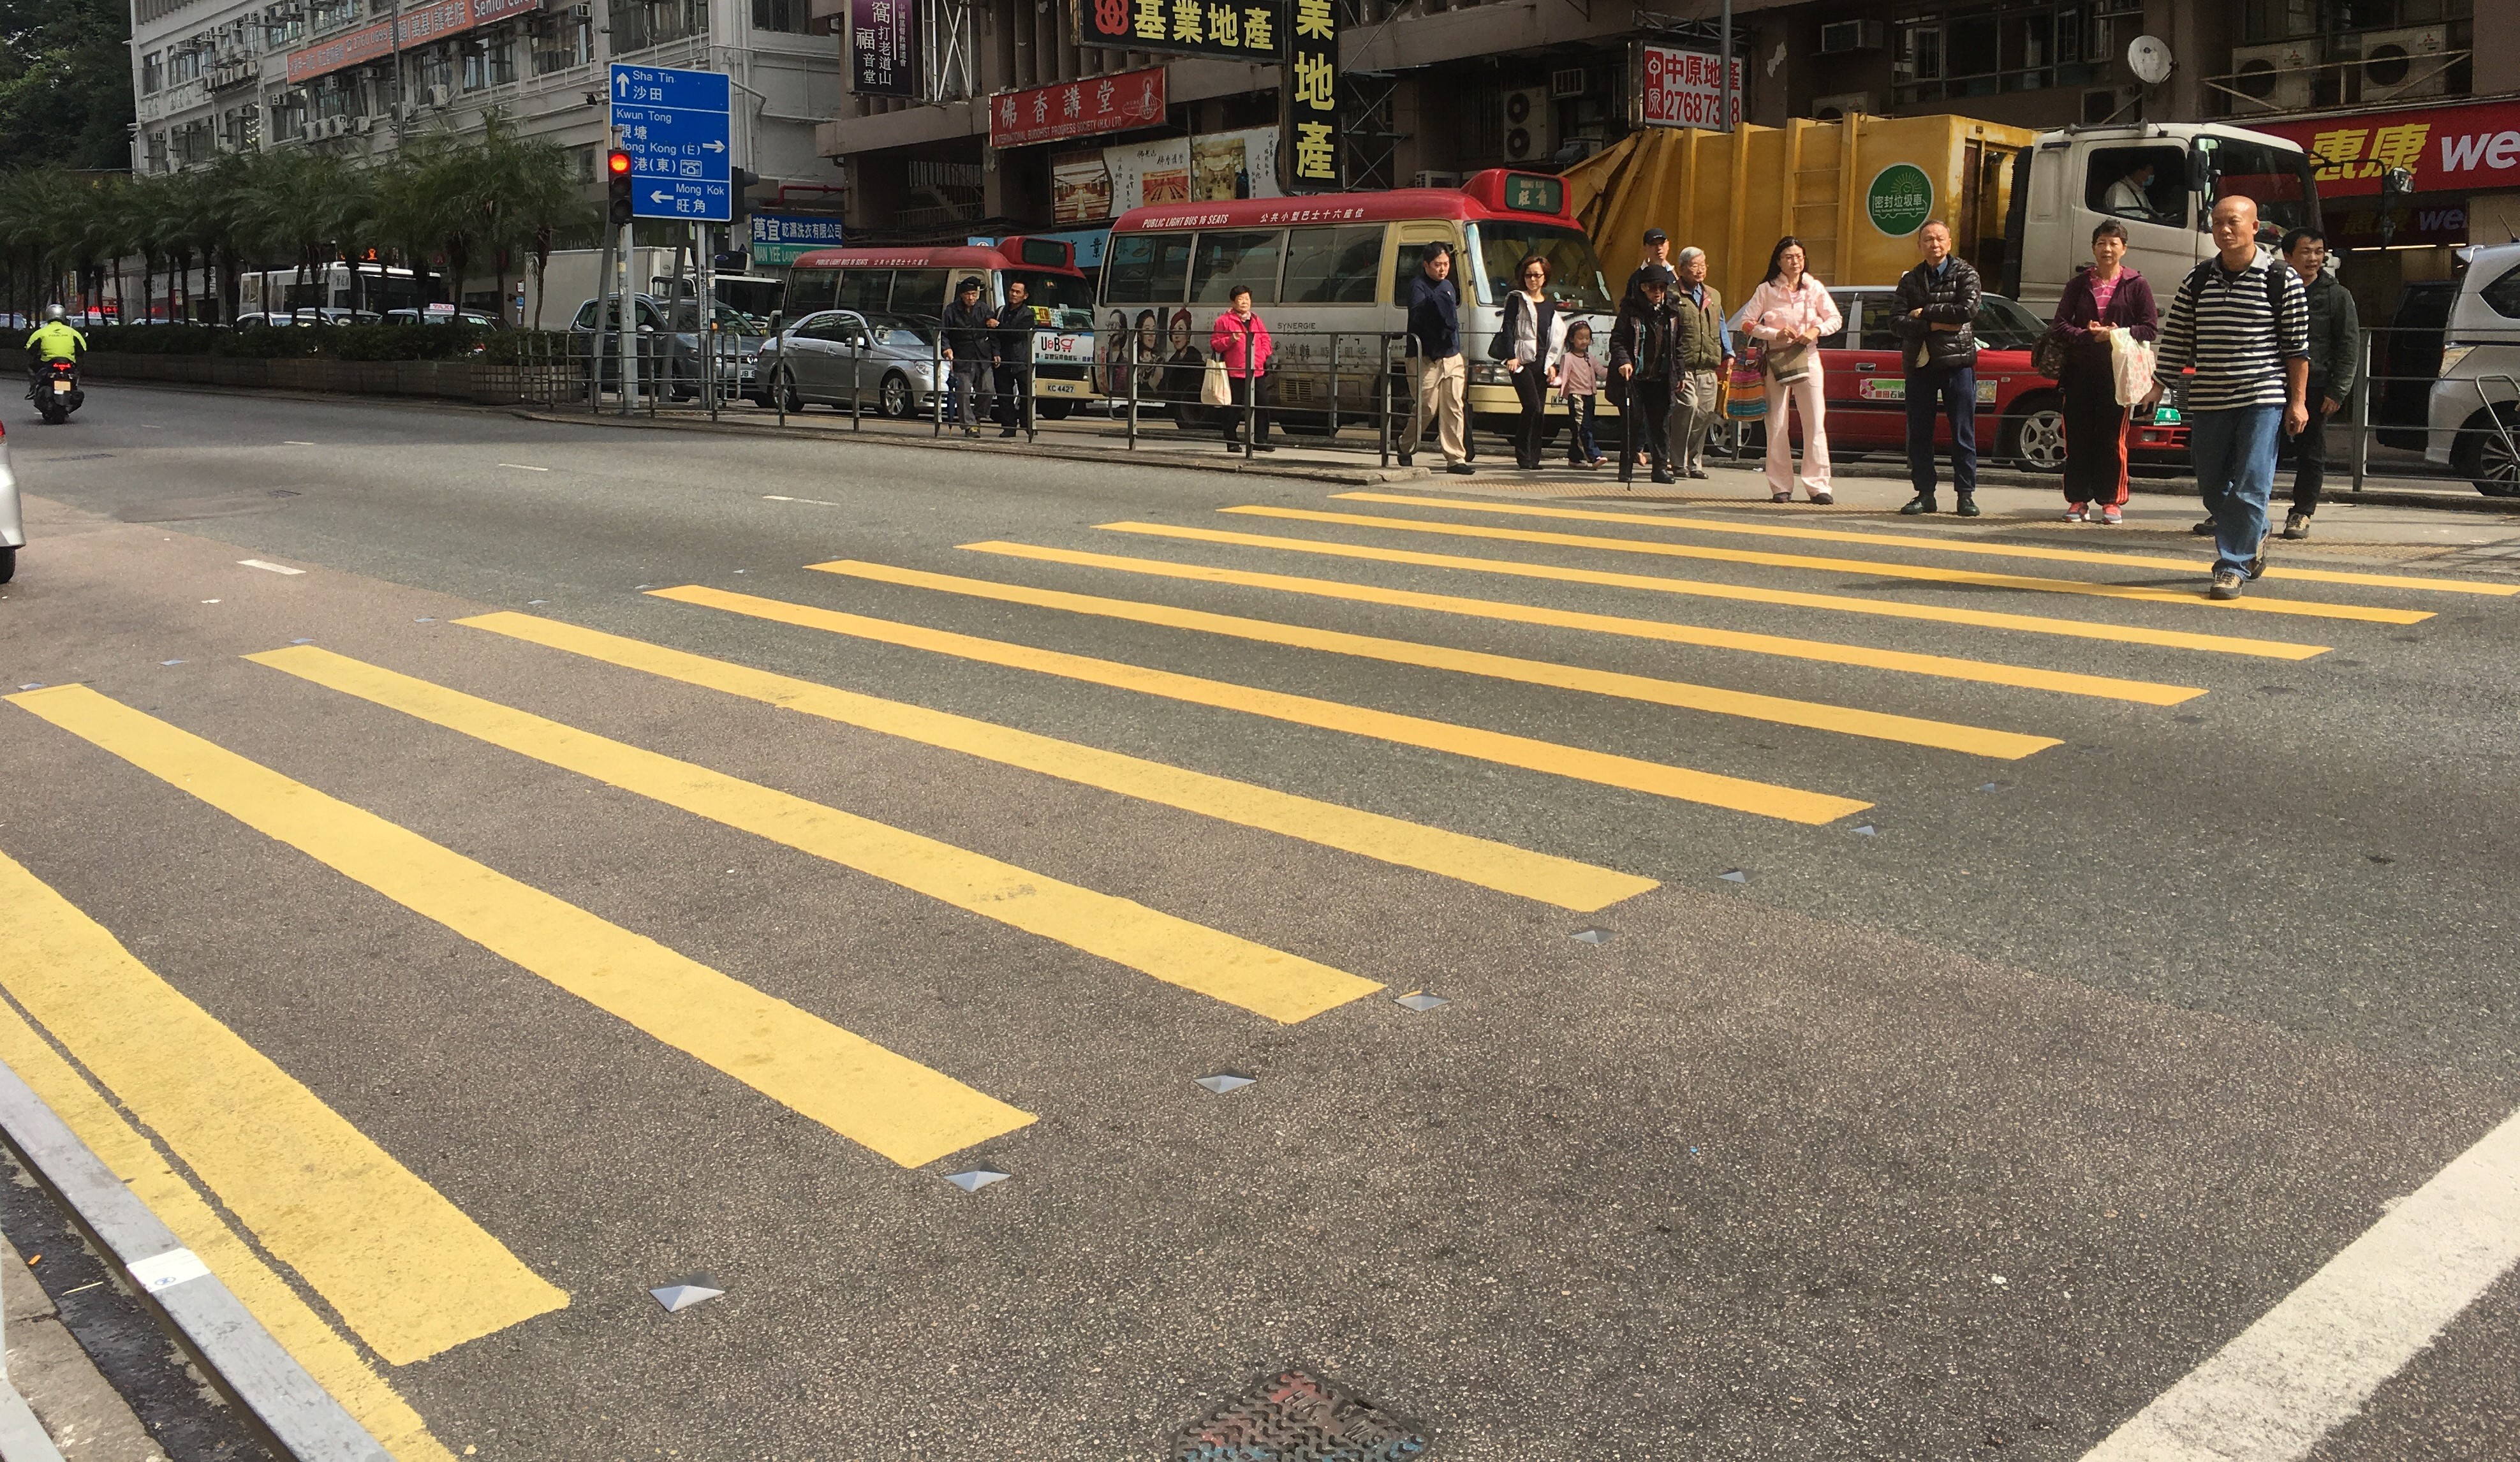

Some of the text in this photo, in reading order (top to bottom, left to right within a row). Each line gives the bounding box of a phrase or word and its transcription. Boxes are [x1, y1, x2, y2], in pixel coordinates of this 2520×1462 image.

[1134, 0, 1274, 50] 基業地產
[872, 1, 892, 85] 窩打老道山
[856, 27, 876, 84] 福音堂
[633, 70, 674, 84] Sha Tin
[1665, 54, 1741, 91] 中原地產
[633, 85, 662, 101] 沙田
[1295, 0, 1336, 179] 業地產
[999, 80, 1115, 129] 佛香講堂
[617, 108, 672, 124] Kwun Tong
[994, 131, 1027, 144] INTERNATIONAL
[1028, 127, 1050, 140] BUDDHIST
[1051, 122, 1075, 136] PROGRESS
[1077, 119, 1096, 133] SOCIETY
[650, 142, 676, 156] Kong
[682, 144, 700, 156] (E)
[2310, 123, 2431, 182] 惠康
[2441, 130, 2520, 172] we
[634, 156, 676, 173] 港(東)
[676, 183, 725, 196] Mong Kok
[677, 198, 705, 213] 旺角
[1875, 193, 1922, 209] 密封垃圾車
[1142, 214, 1229, 228] PUBLIC LIGHT BUS 16 SEATS
[1260, 207, 1364, 223] 公共小型巴士十六座位
[2419, 209, 2465, 231] we
[753, 217, 780, 241] 萬宜
[754, 246, 767, 262] MAN
[769, 246, 780, 262] YEE
[1278, 322, 1316, 332] SYNERGIE
[1040, 336, 1061, 351] U&B
